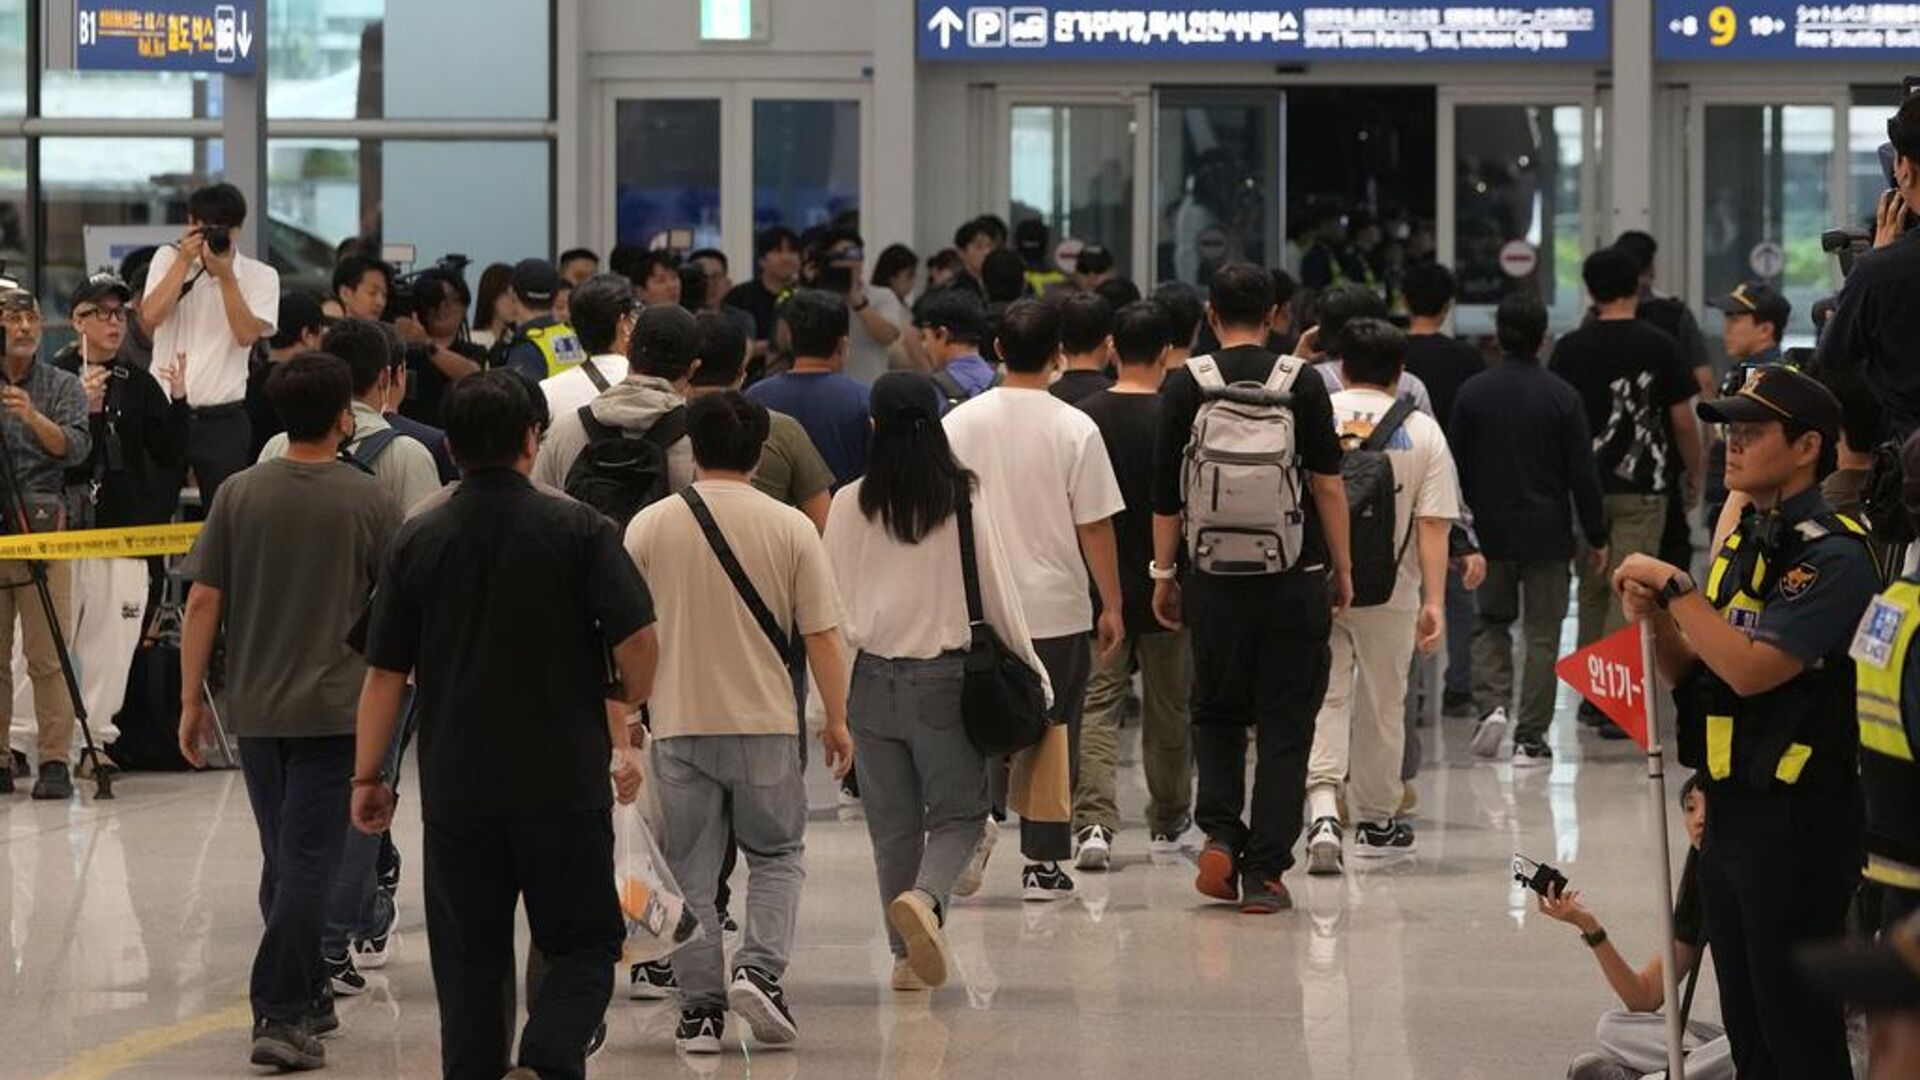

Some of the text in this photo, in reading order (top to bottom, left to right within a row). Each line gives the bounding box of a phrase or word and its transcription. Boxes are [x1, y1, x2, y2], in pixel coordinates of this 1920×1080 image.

[79, 11, 96, 45] B1
[1708, 6, 1737, 47] 9
[1587, 653, 1644, 708] 인1기-
